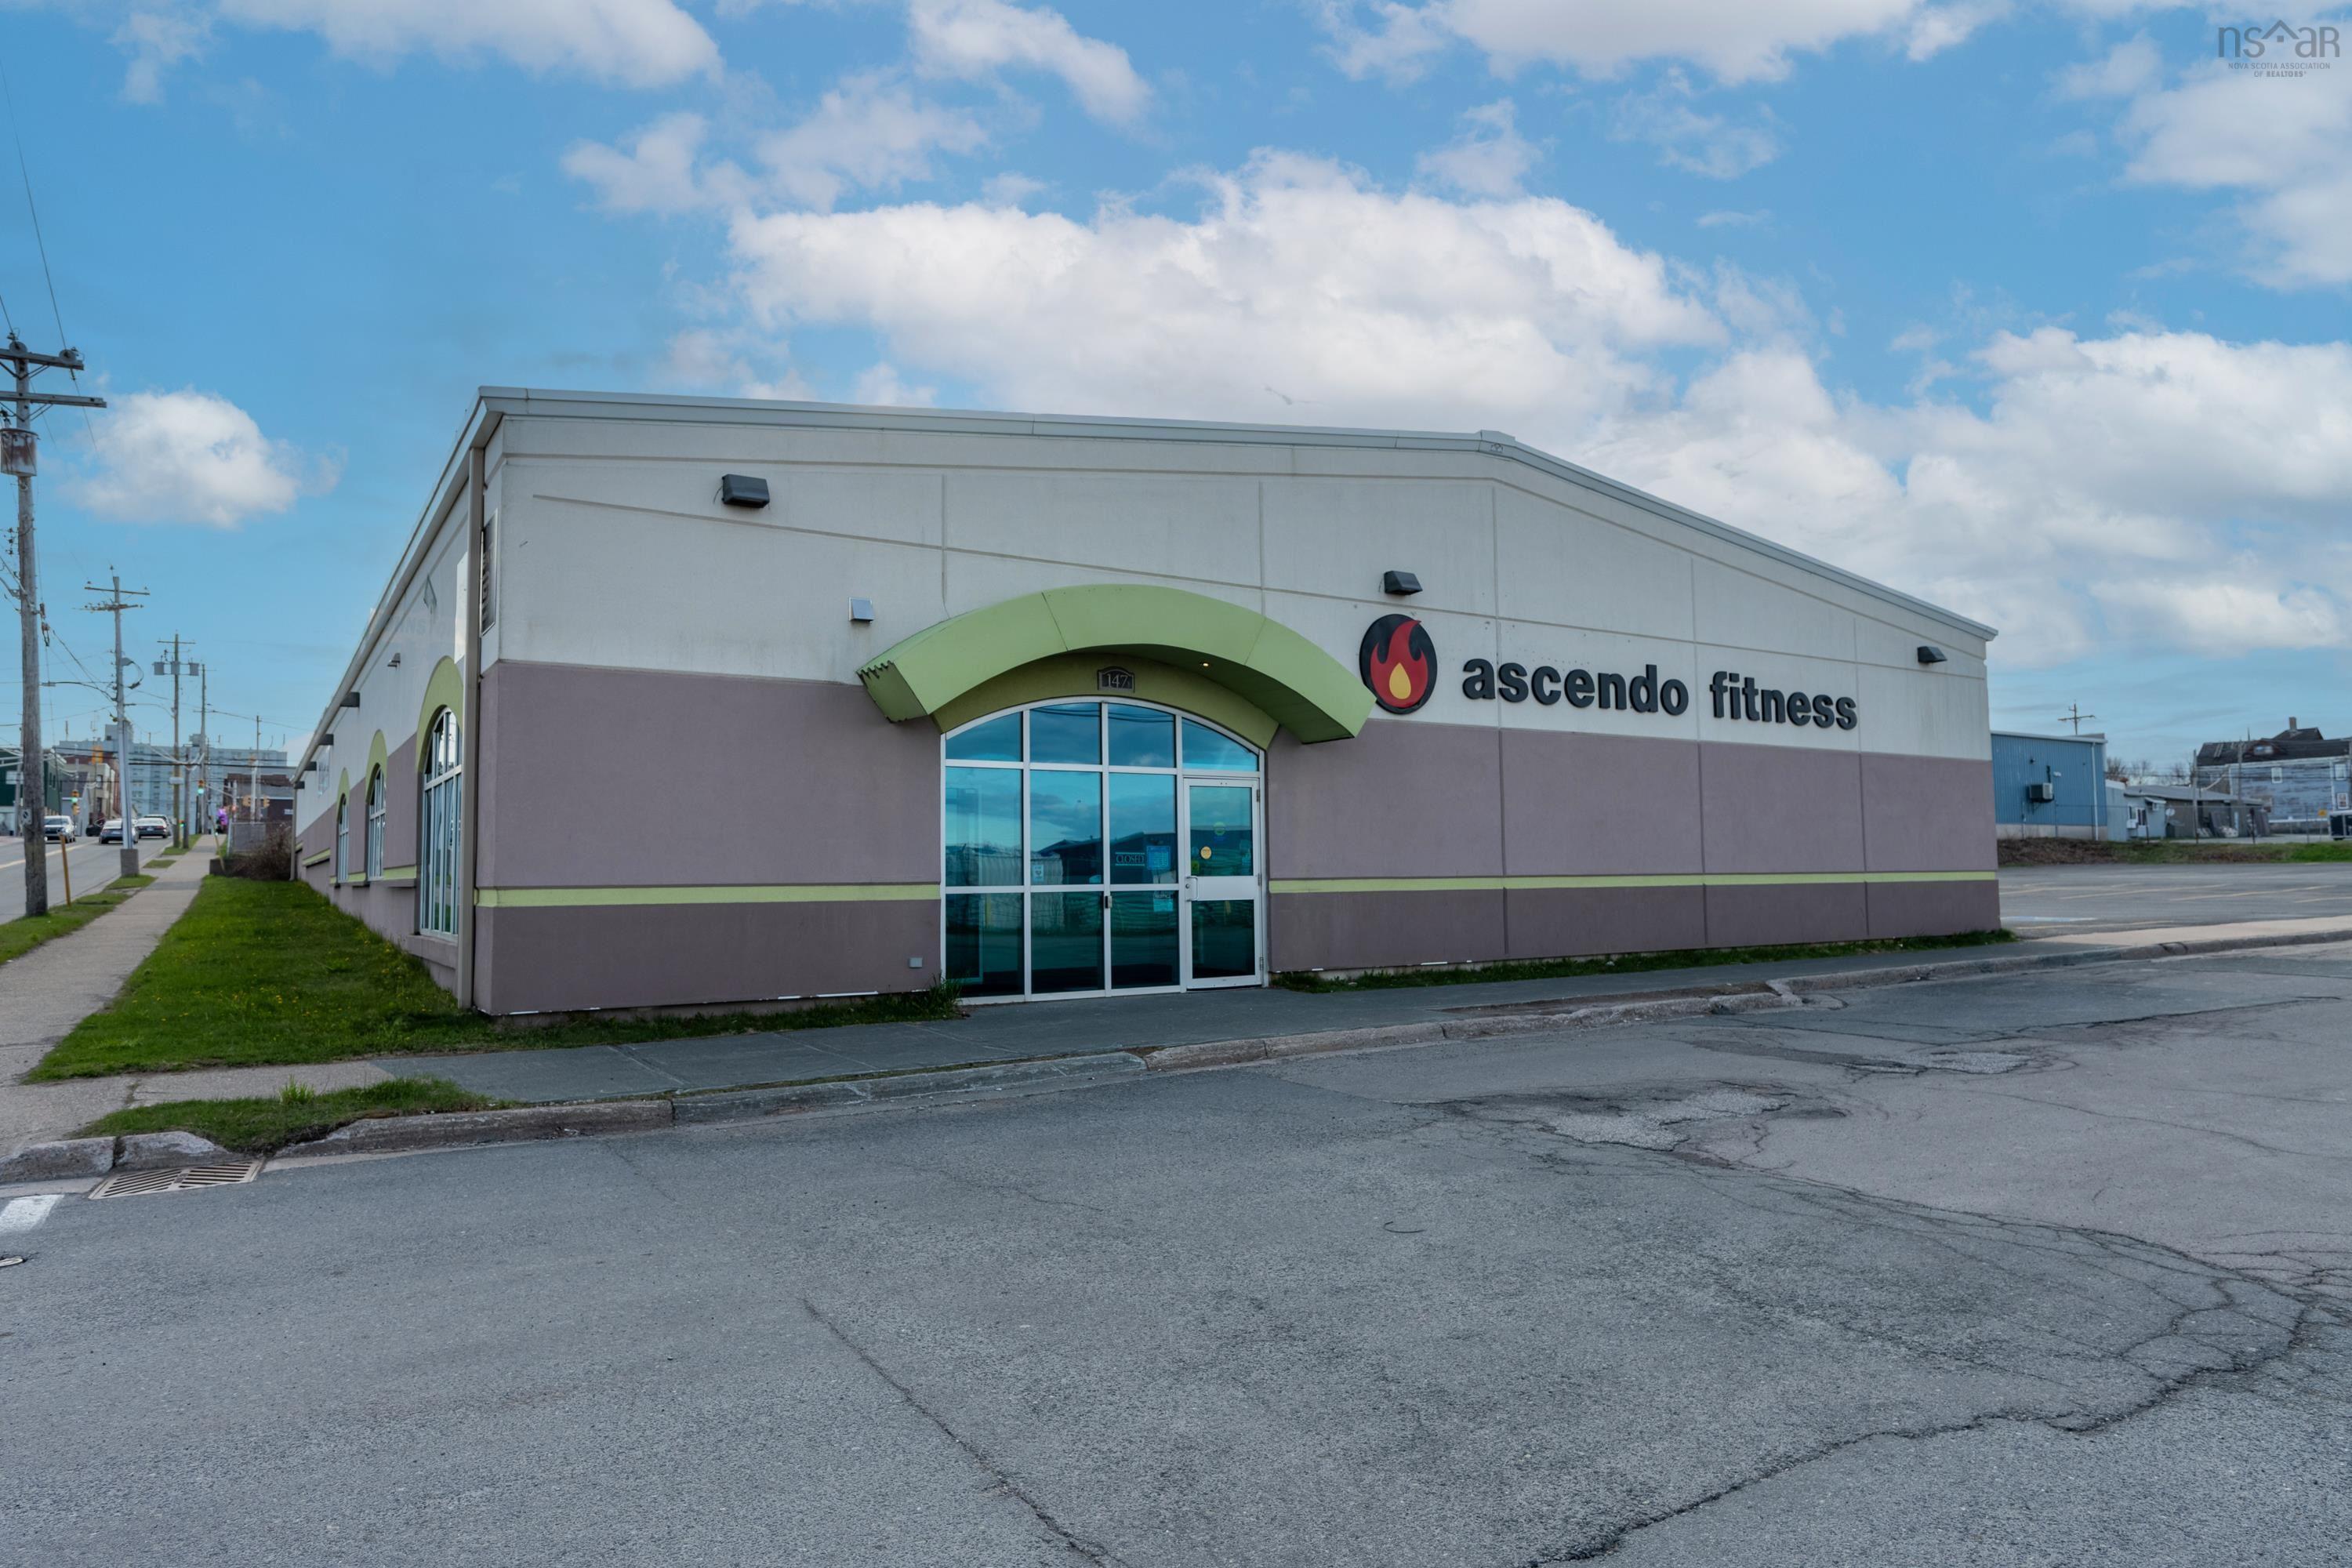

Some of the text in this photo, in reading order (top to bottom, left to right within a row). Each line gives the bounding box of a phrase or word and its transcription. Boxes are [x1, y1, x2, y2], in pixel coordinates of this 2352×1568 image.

[1107, 673, 1129, 689] 147
[1462, 657, 1858, 731] ascendo fitness
